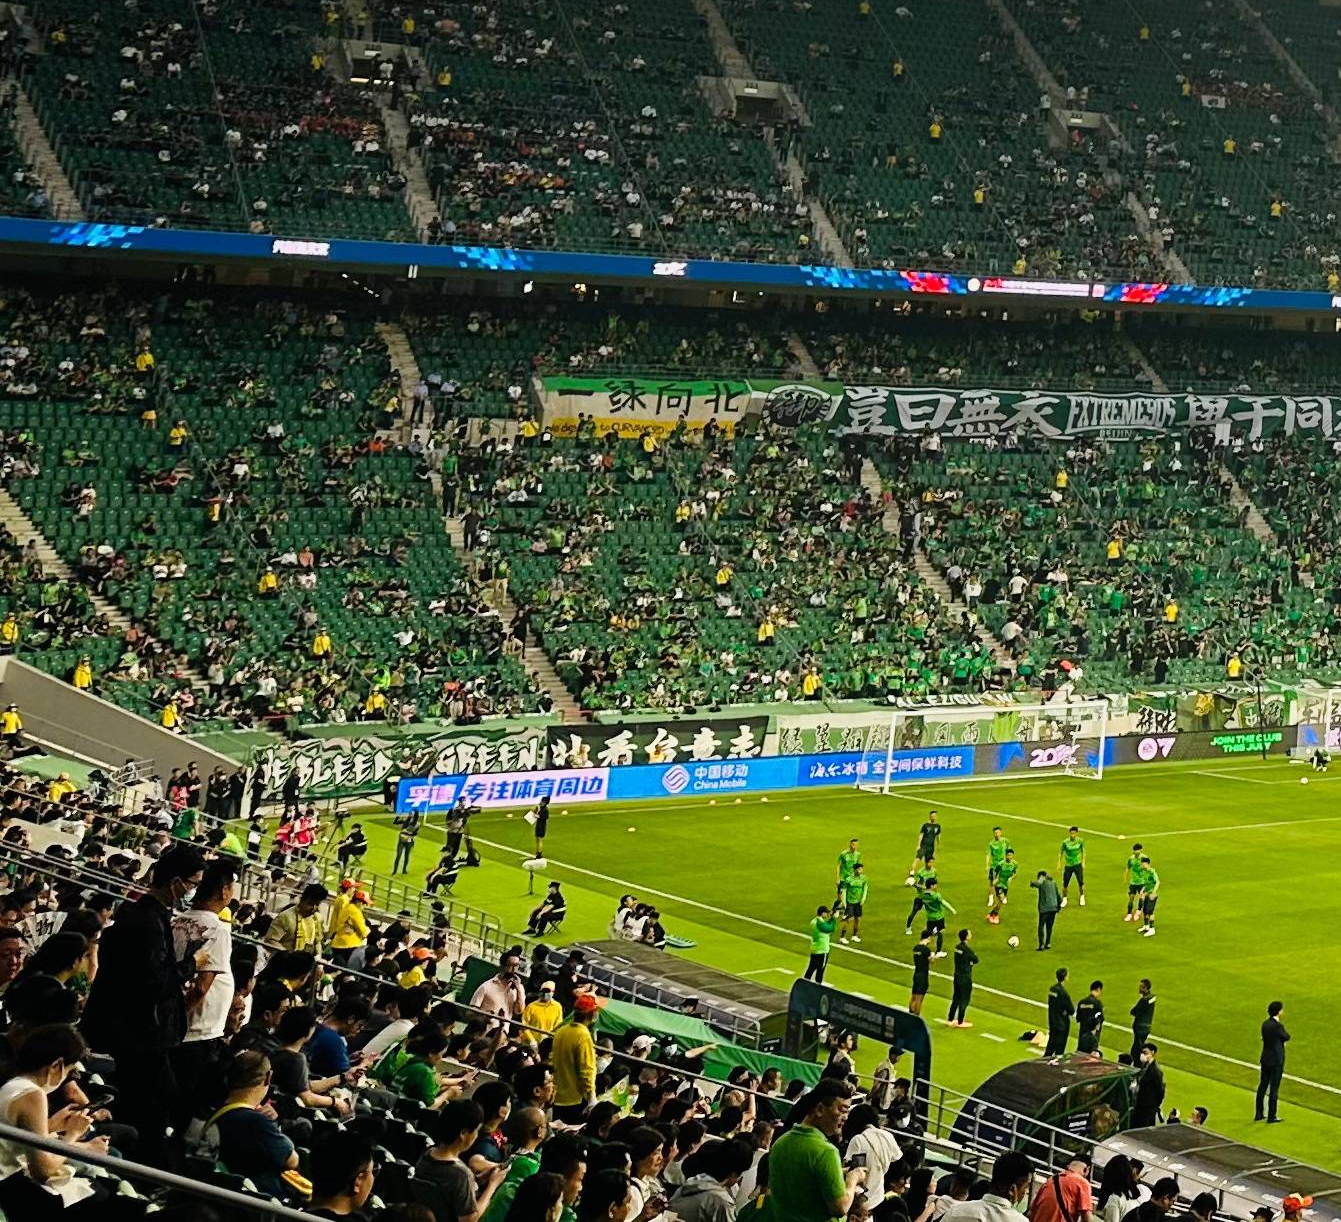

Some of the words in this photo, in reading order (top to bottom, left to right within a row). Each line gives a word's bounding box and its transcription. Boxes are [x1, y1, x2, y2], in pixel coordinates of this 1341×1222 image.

[1210, 735, 1235, 747] JOIN
[1235, 734, 1255, 744] THE
[1222, 744, 1244, 753] THIS
[295, 749, 396, 788] BLEED
[434, 737, 537, 775] GREEN
[694, 764, 748, 779] 中国移动
[464, 777, 604, 803] 专注体育周边
[694, 780, 719, 791] China
[719, 779, 747, 789] Mobile
